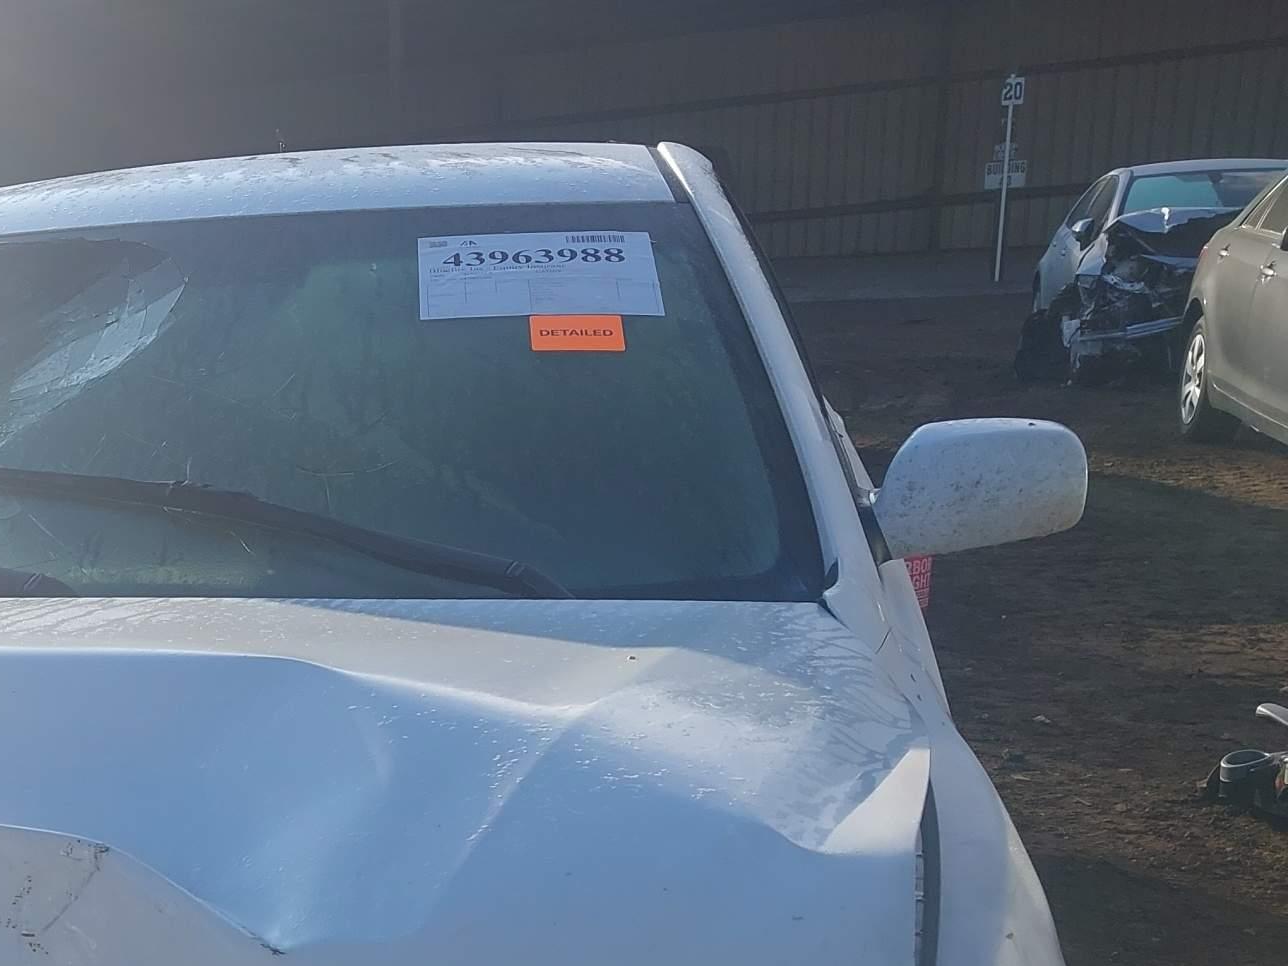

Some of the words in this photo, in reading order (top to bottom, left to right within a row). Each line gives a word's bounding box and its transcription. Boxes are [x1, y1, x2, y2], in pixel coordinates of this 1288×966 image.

[1003, 82, 1022, 101] 20
[987, 162, 1025, 176] BUIING
[442, 248, 626, 267] 43963988
[539, 328, 614, 337] DETAILED
